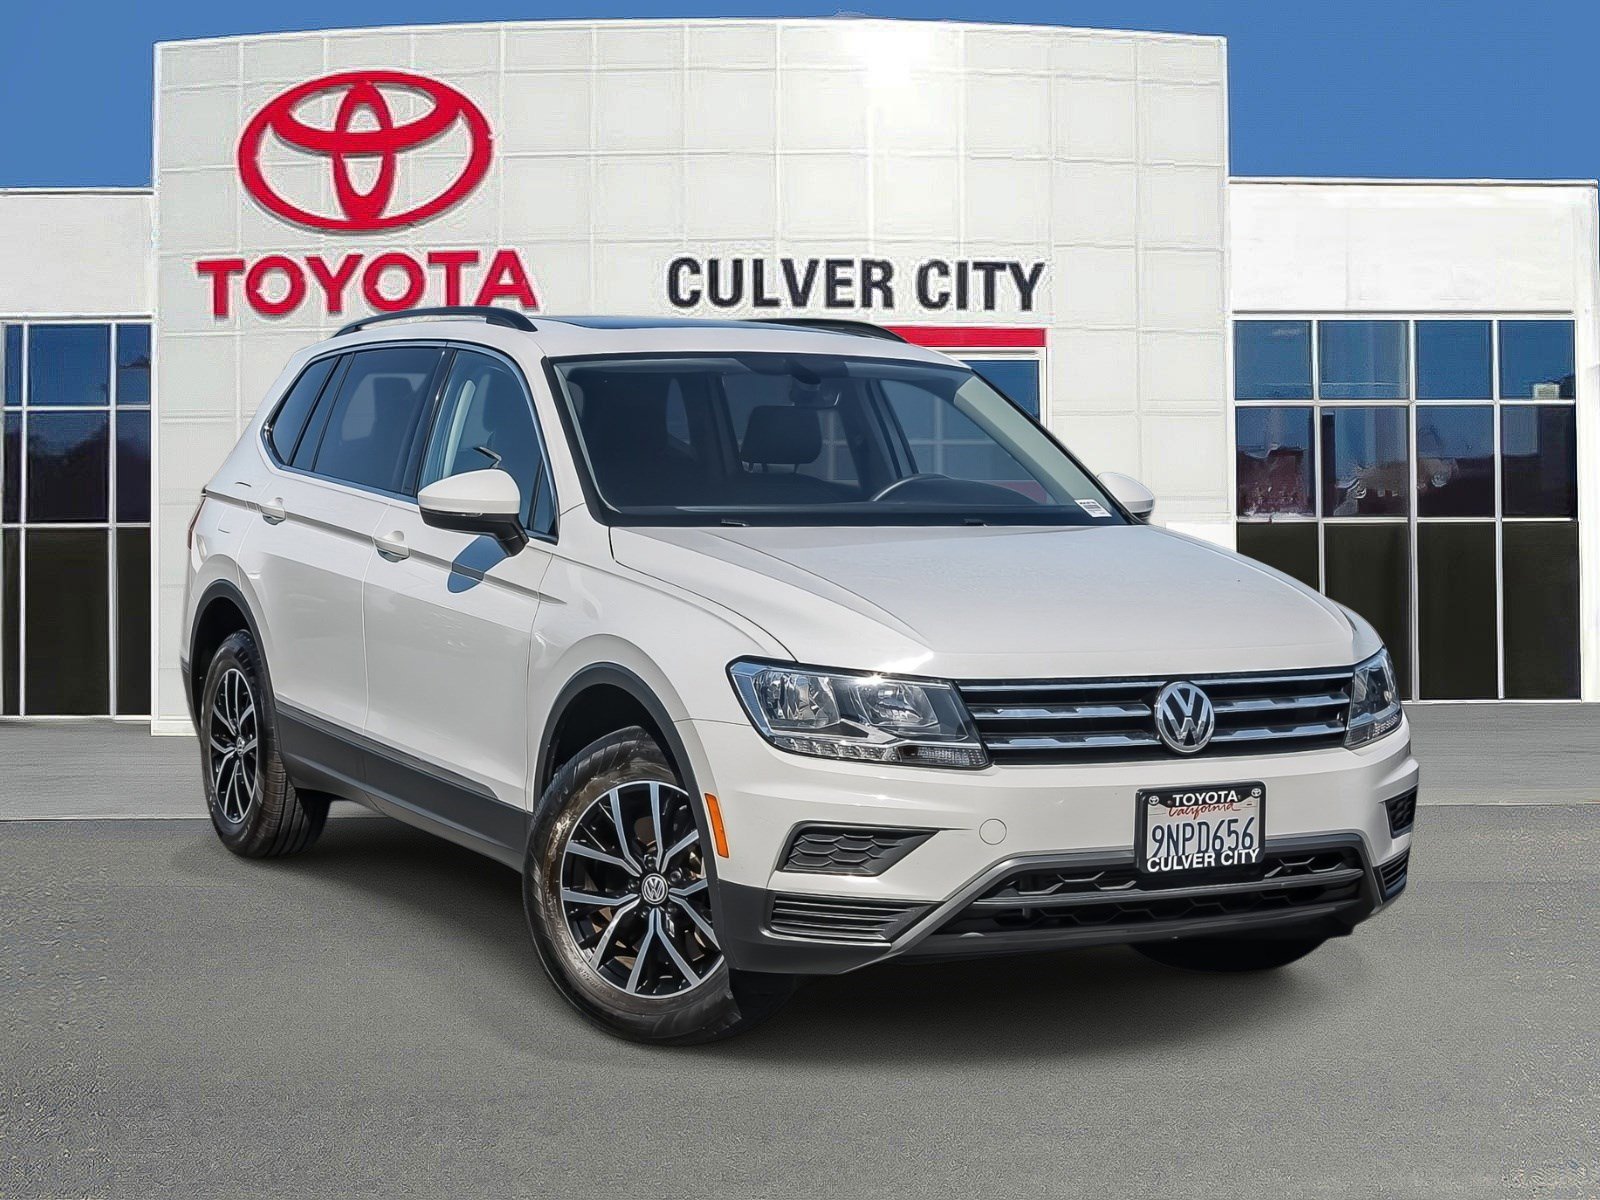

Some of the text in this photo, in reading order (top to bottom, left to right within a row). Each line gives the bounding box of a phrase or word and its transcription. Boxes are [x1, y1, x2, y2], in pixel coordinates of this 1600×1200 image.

[195, 249, 539, 318] TOYOTA
[668, 257, 1046, 311] CULVER CITY
[1172, 789, 1239, 807] TOYOTA
[1151, 816, 1256, 859] 9NPD656
[1146, 847, 1260, 873] CULVER CITY
